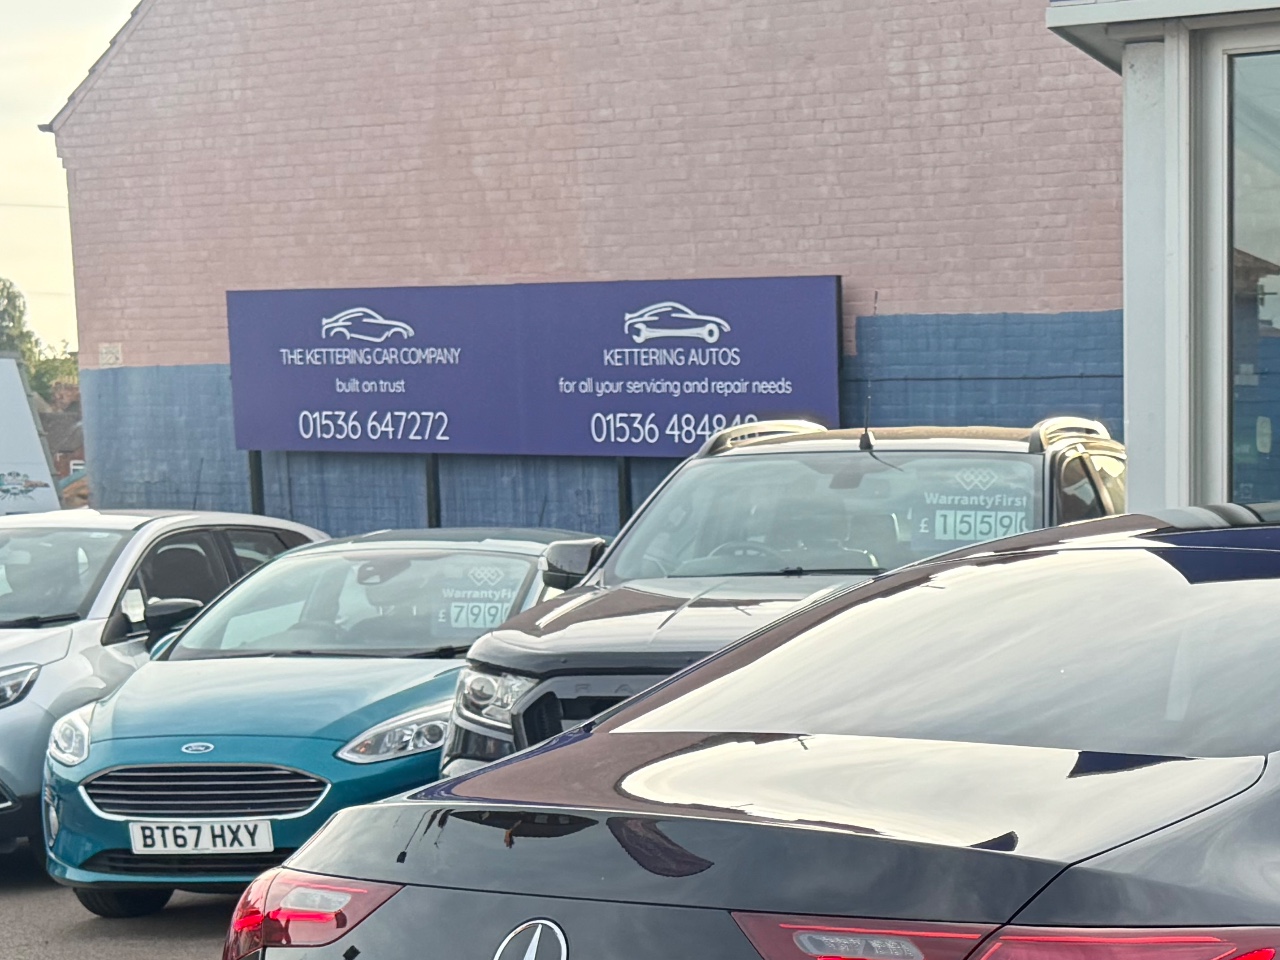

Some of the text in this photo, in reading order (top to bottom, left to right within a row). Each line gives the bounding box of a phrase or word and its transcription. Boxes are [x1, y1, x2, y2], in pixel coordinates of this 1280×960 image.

[280, 347, 461, 365] THE KETTERING CAR COMPANY
[603, 347, 741, 366] KETTERING AUTOS
[335, 377, 406, 393] built on trust
[558, 377, 793, 397] for all your servicing and repair needs
[299, 410, 450, 440] 01536 647272
[590, 412, 660, 443] 01536
[140, 823, 259, 849] BT67 HXY
